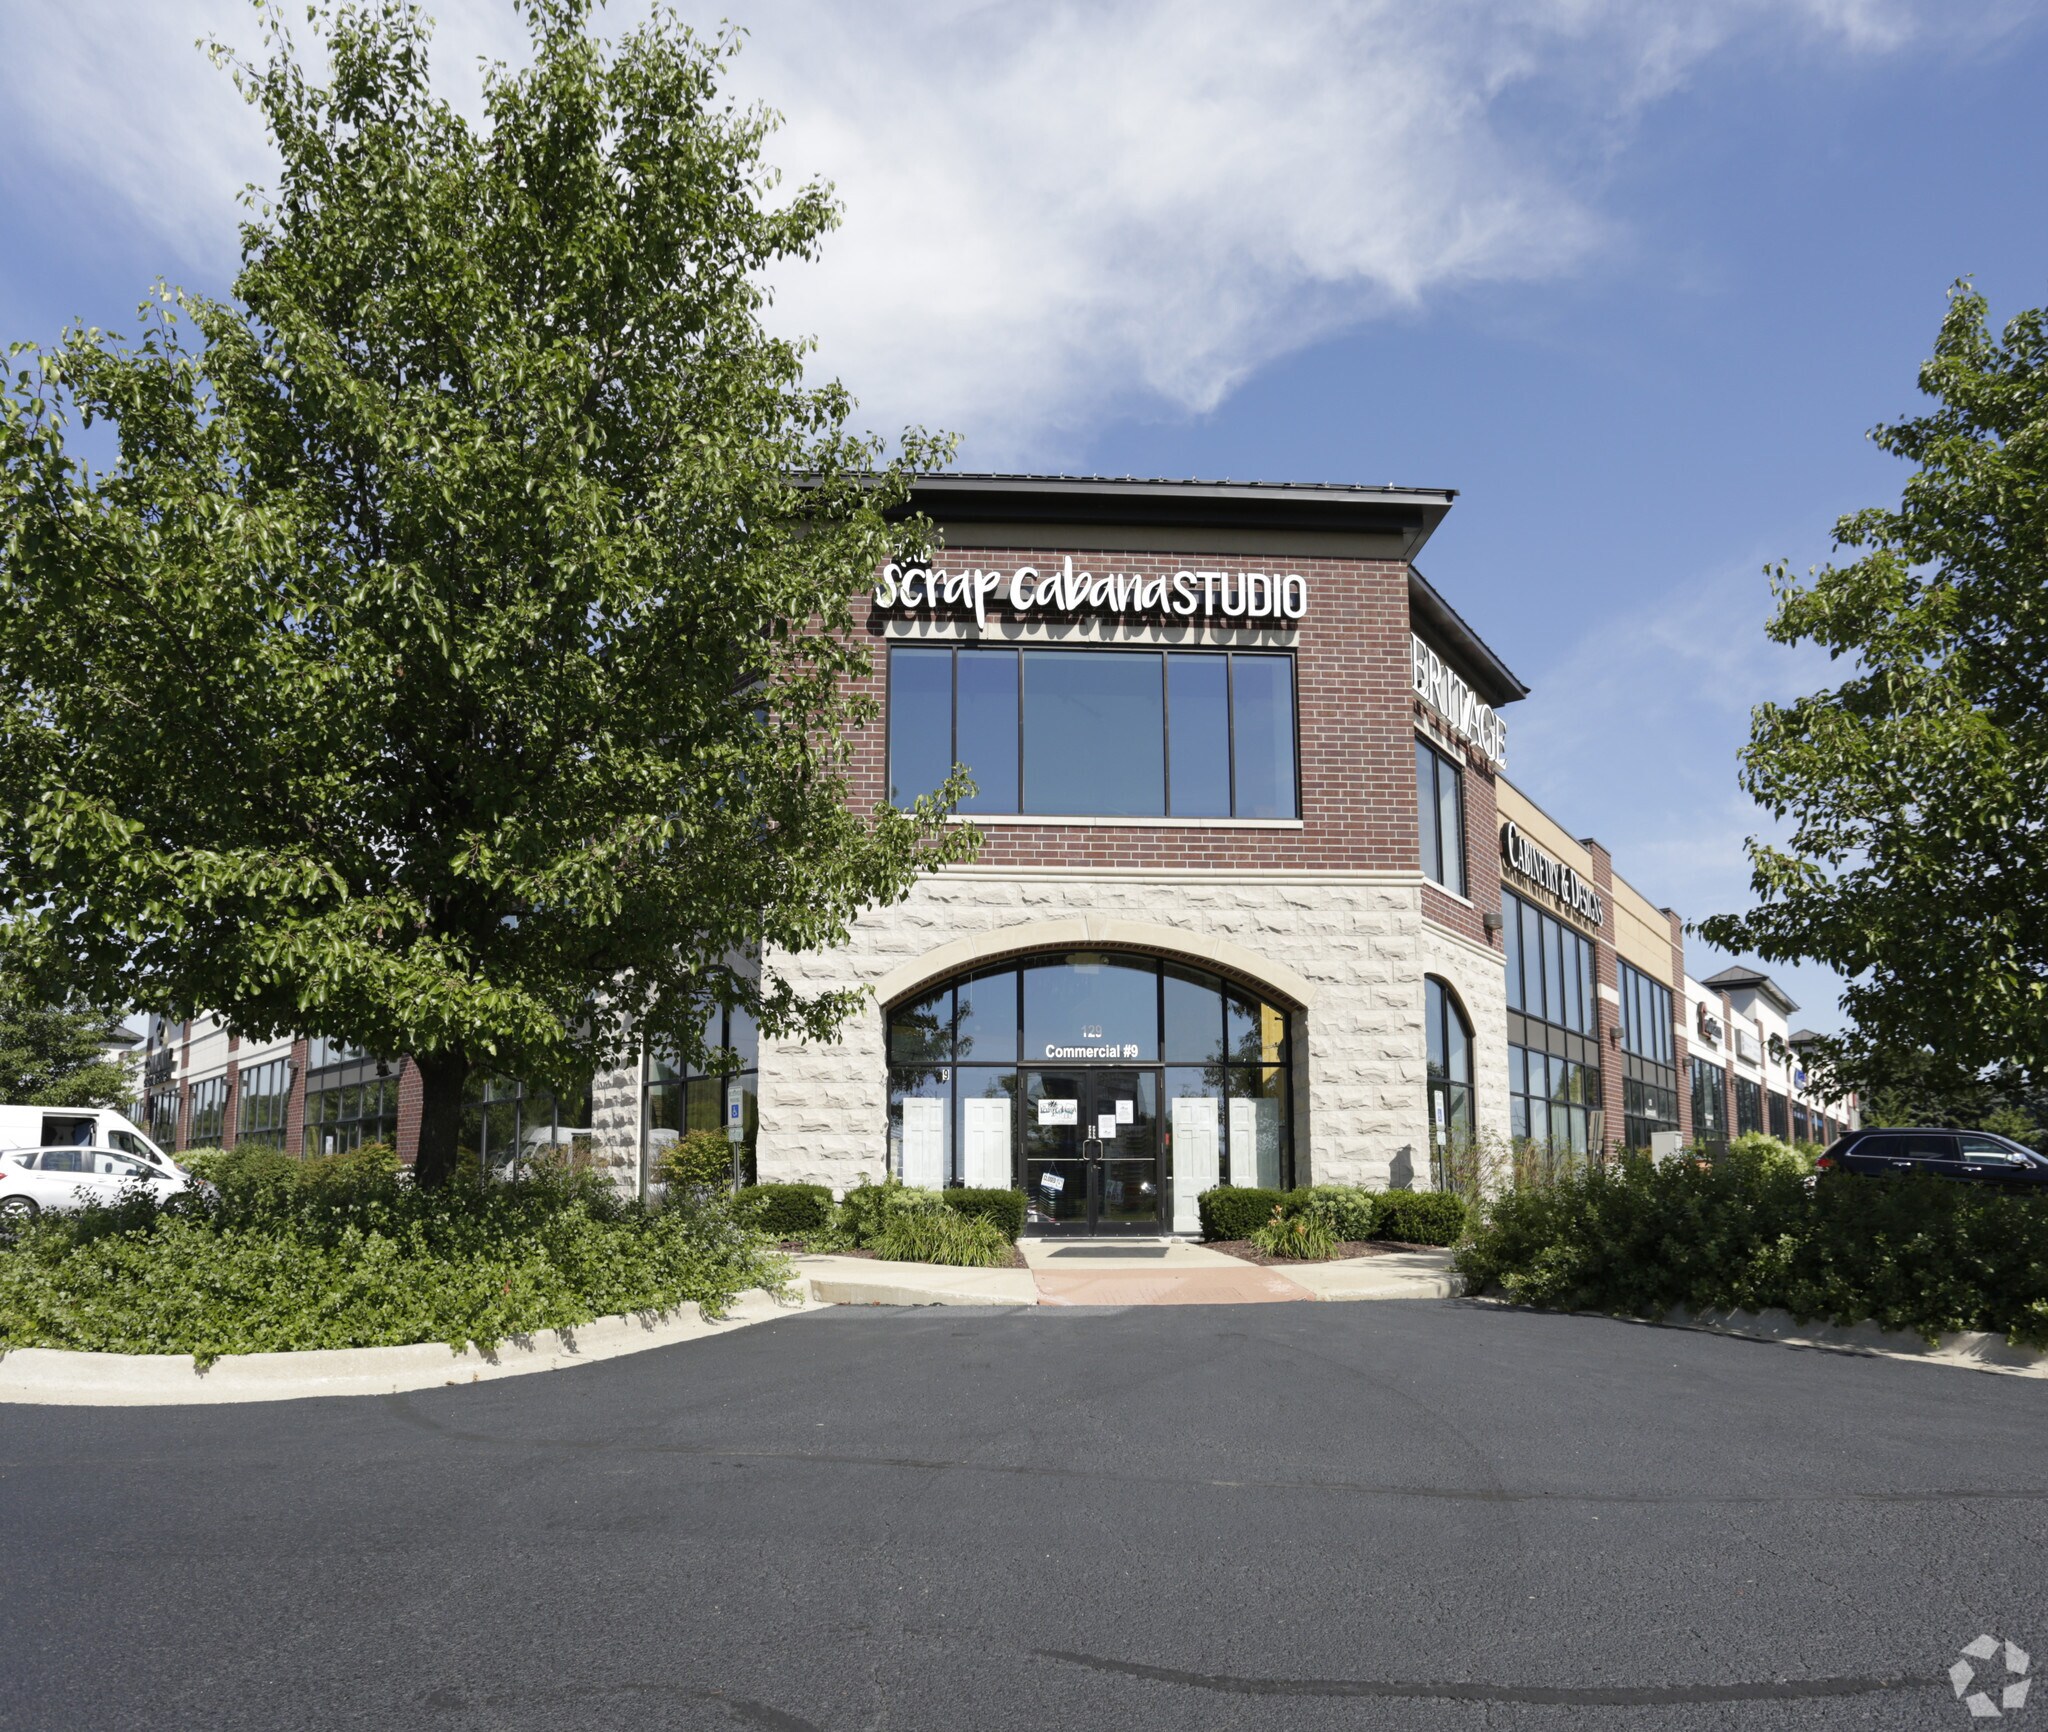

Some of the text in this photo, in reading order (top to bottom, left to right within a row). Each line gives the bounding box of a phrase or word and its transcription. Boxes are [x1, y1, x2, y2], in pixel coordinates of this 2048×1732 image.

[1081, 1024, 1102, 1038] 129
[1045, 1044, 1139, 1058] Commercial #9
